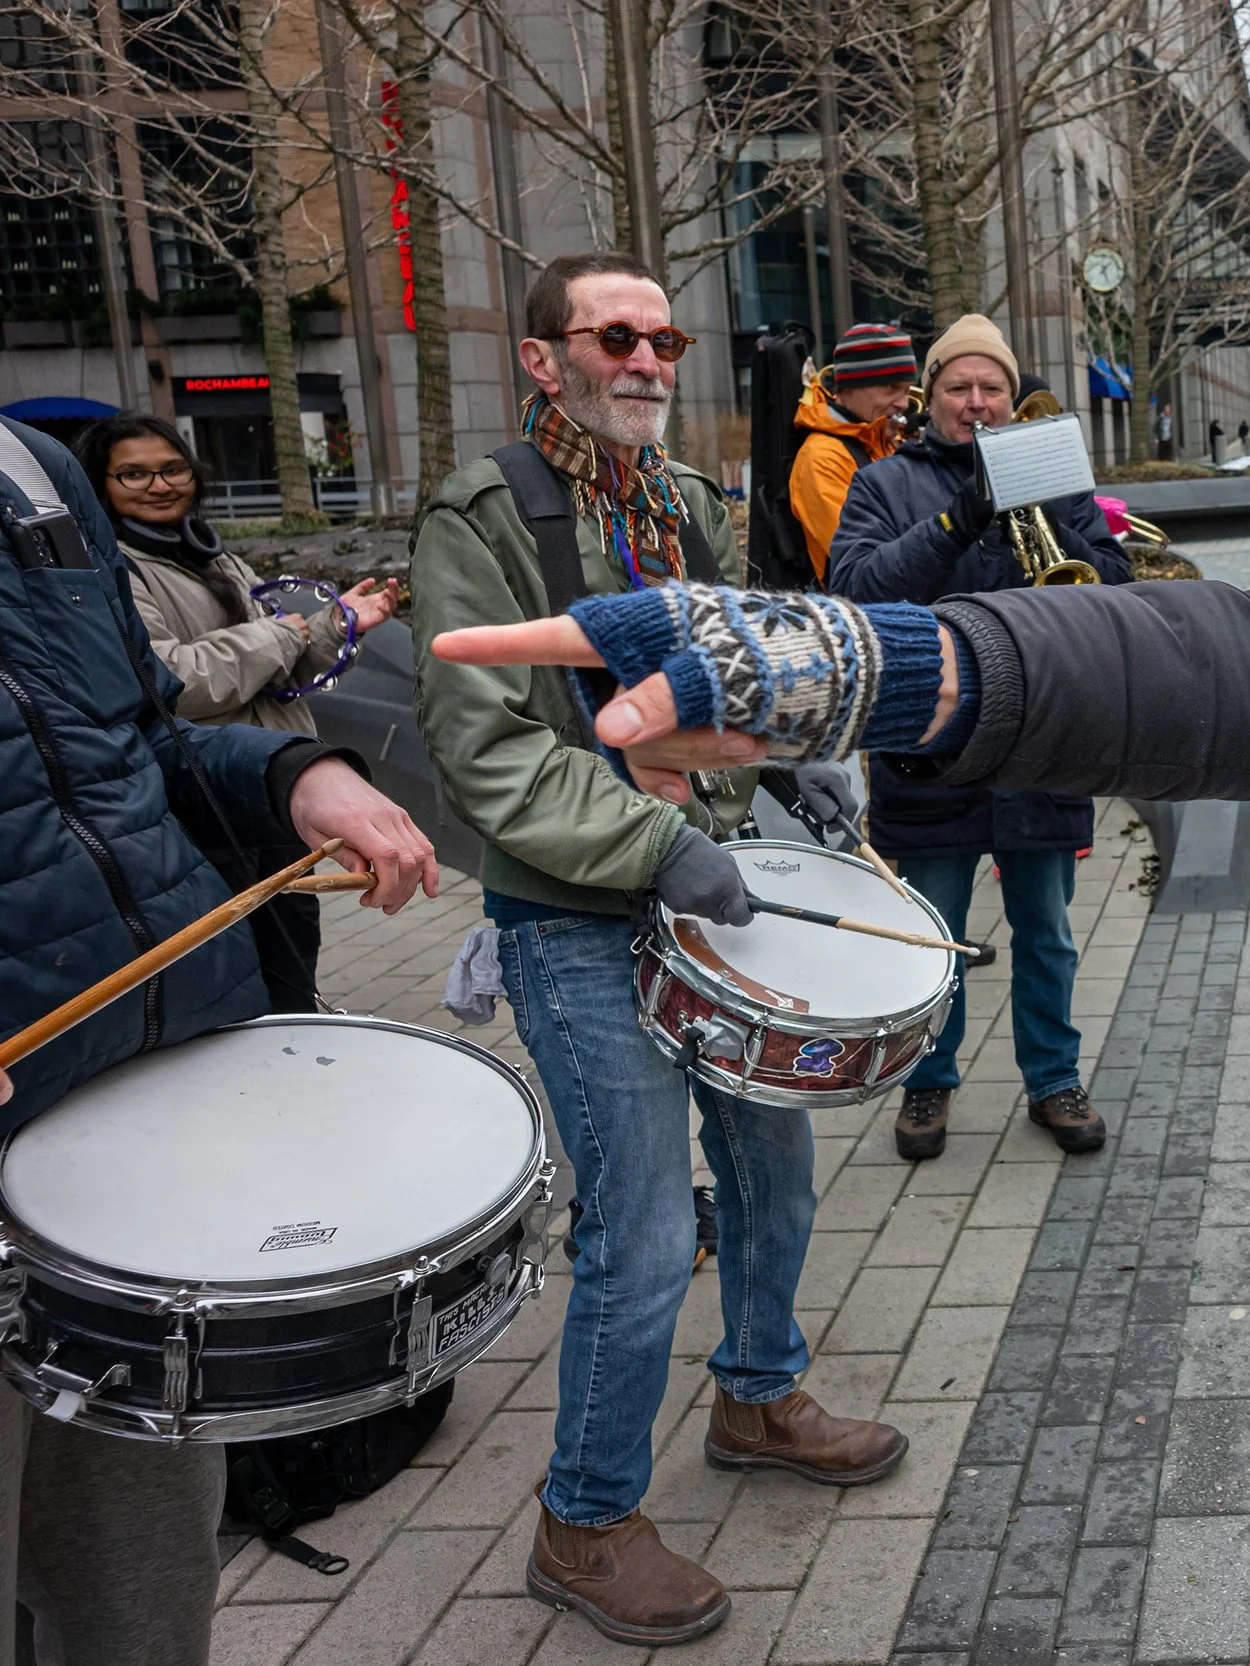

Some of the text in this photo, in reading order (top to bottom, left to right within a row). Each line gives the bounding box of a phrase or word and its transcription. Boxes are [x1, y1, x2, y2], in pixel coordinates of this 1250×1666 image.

[438, 1306, 459, 1325] THIS
[438, 1286, 504, 1353] FASCISTS
[443, 1285, 498, 1336] KILLS
